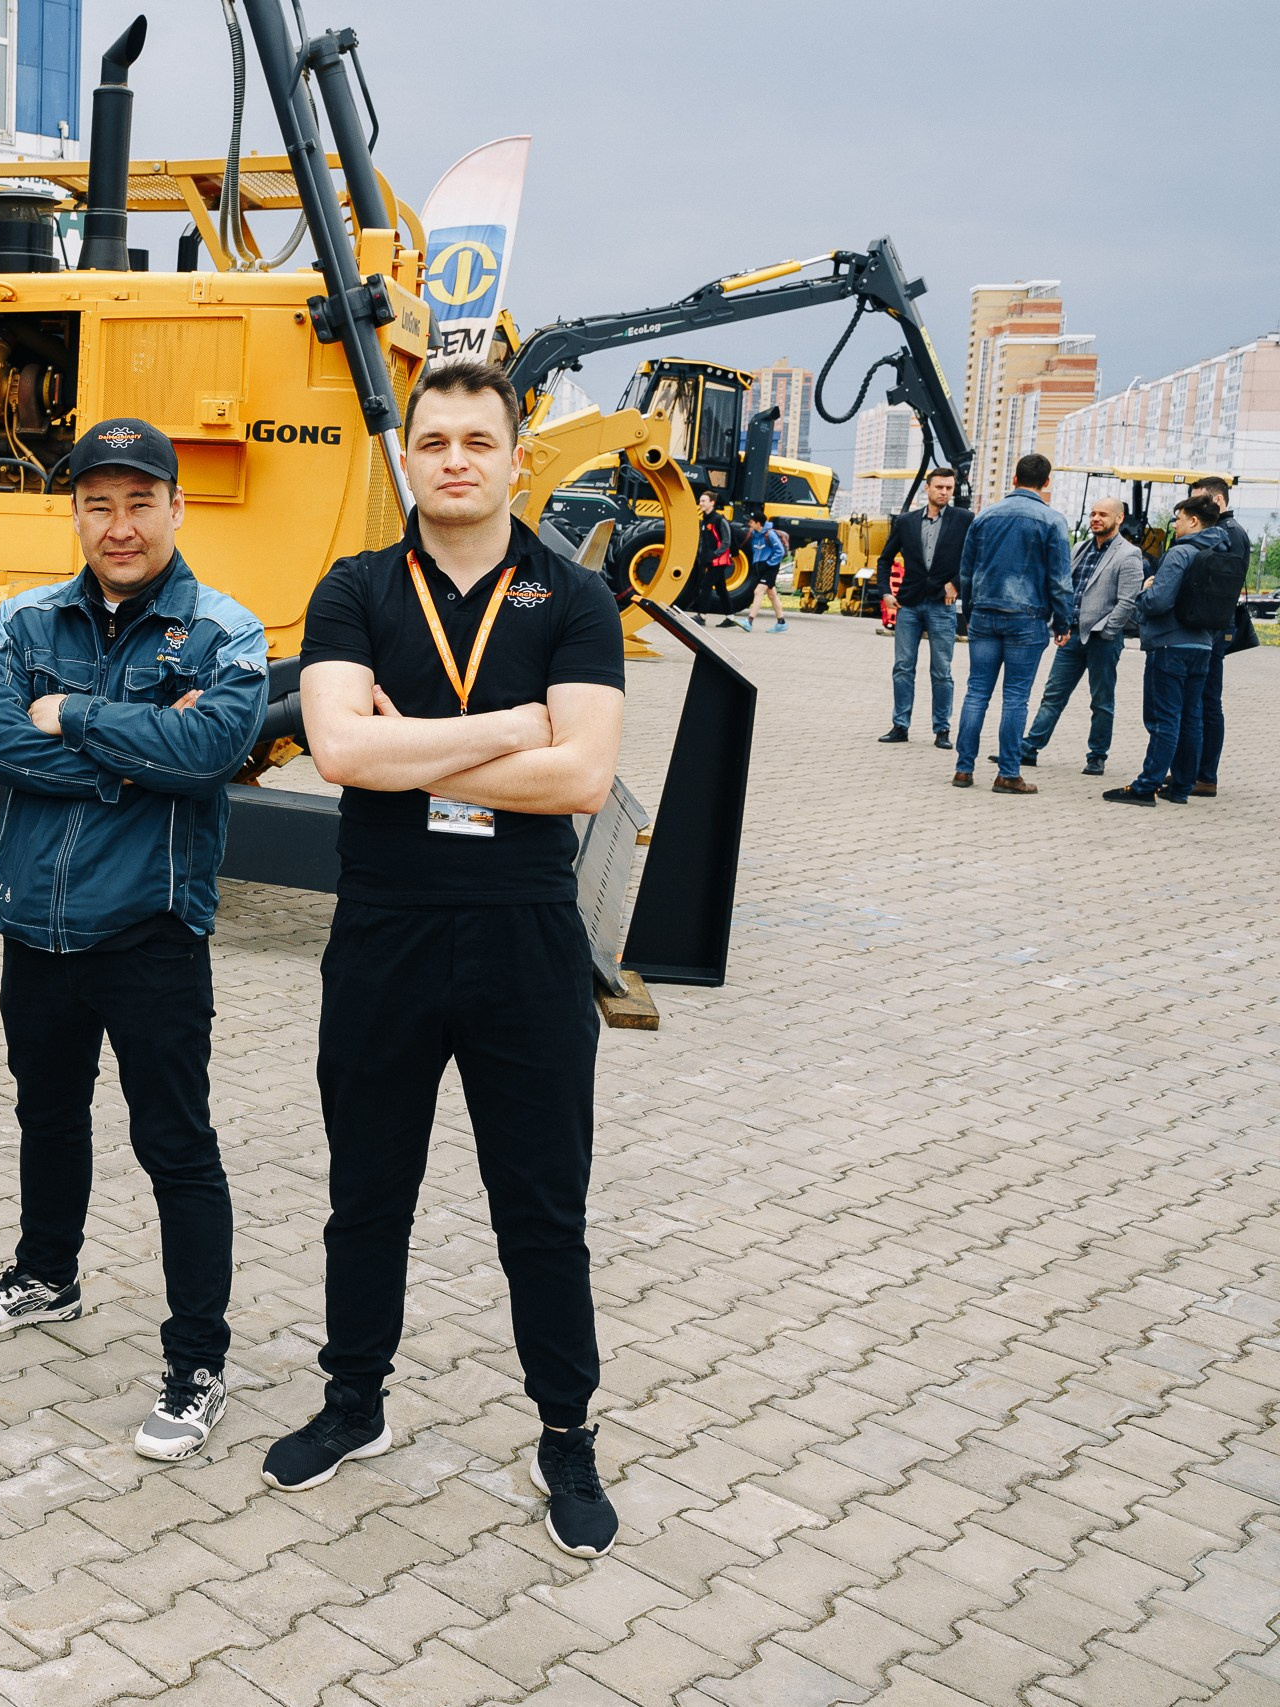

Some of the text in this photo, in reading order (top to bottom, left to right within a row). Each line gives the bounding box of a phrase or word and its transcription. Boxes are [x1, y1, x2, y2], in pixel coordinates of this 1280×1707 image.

[627, 322, 661, 337] EcoLog
[427, 328, 487, 359] EM
[245, 419, 342, 445] GONG
